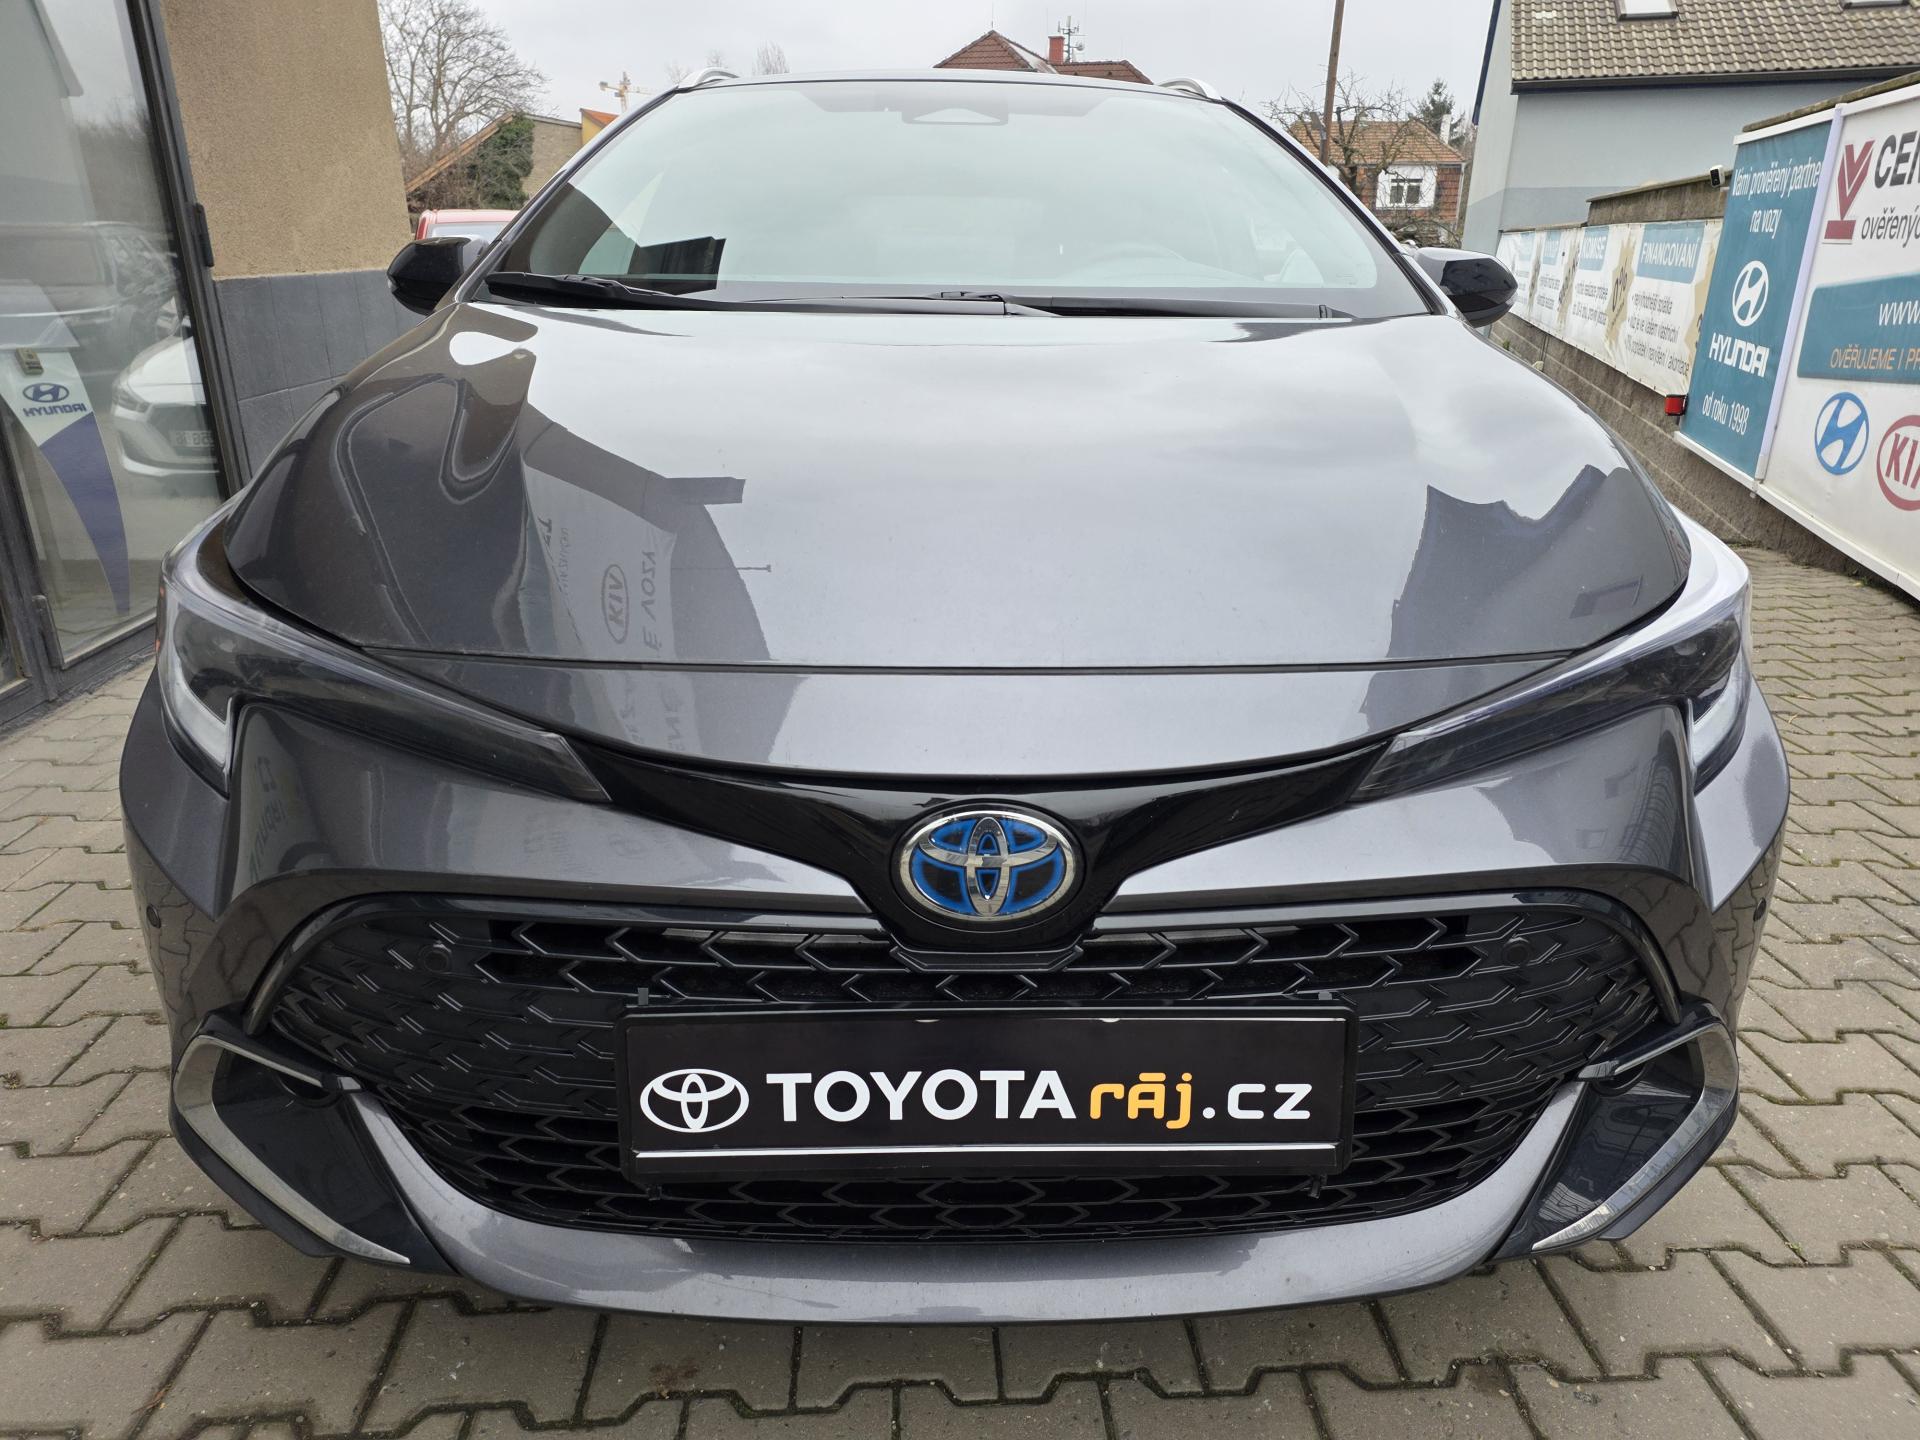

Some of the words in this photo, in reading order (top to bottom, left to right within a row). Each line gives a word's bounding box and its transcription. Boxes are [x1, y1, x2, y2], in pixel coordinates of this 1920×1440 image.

[1748, 158, 1792, 200] prověřený
[1749, 209, 1762, 233] na
[1761, 208, 1782, 239] vozy
[1640, 238, 1700, 269] FINANCOVÁNÍ
[1709, 332, 1770, 377] HYUNDAI
[1830, 344, 1897, 370] OVĚŘUJEME
[22, 403, 87, 417] HYUNDAI
[1702, 391, 1714, 417] od
[1711, 395, 1729, 425] roku
[1728, 401, 1750, 435] 1998
[766, 1068, 1076, 1122] TOYOTA
